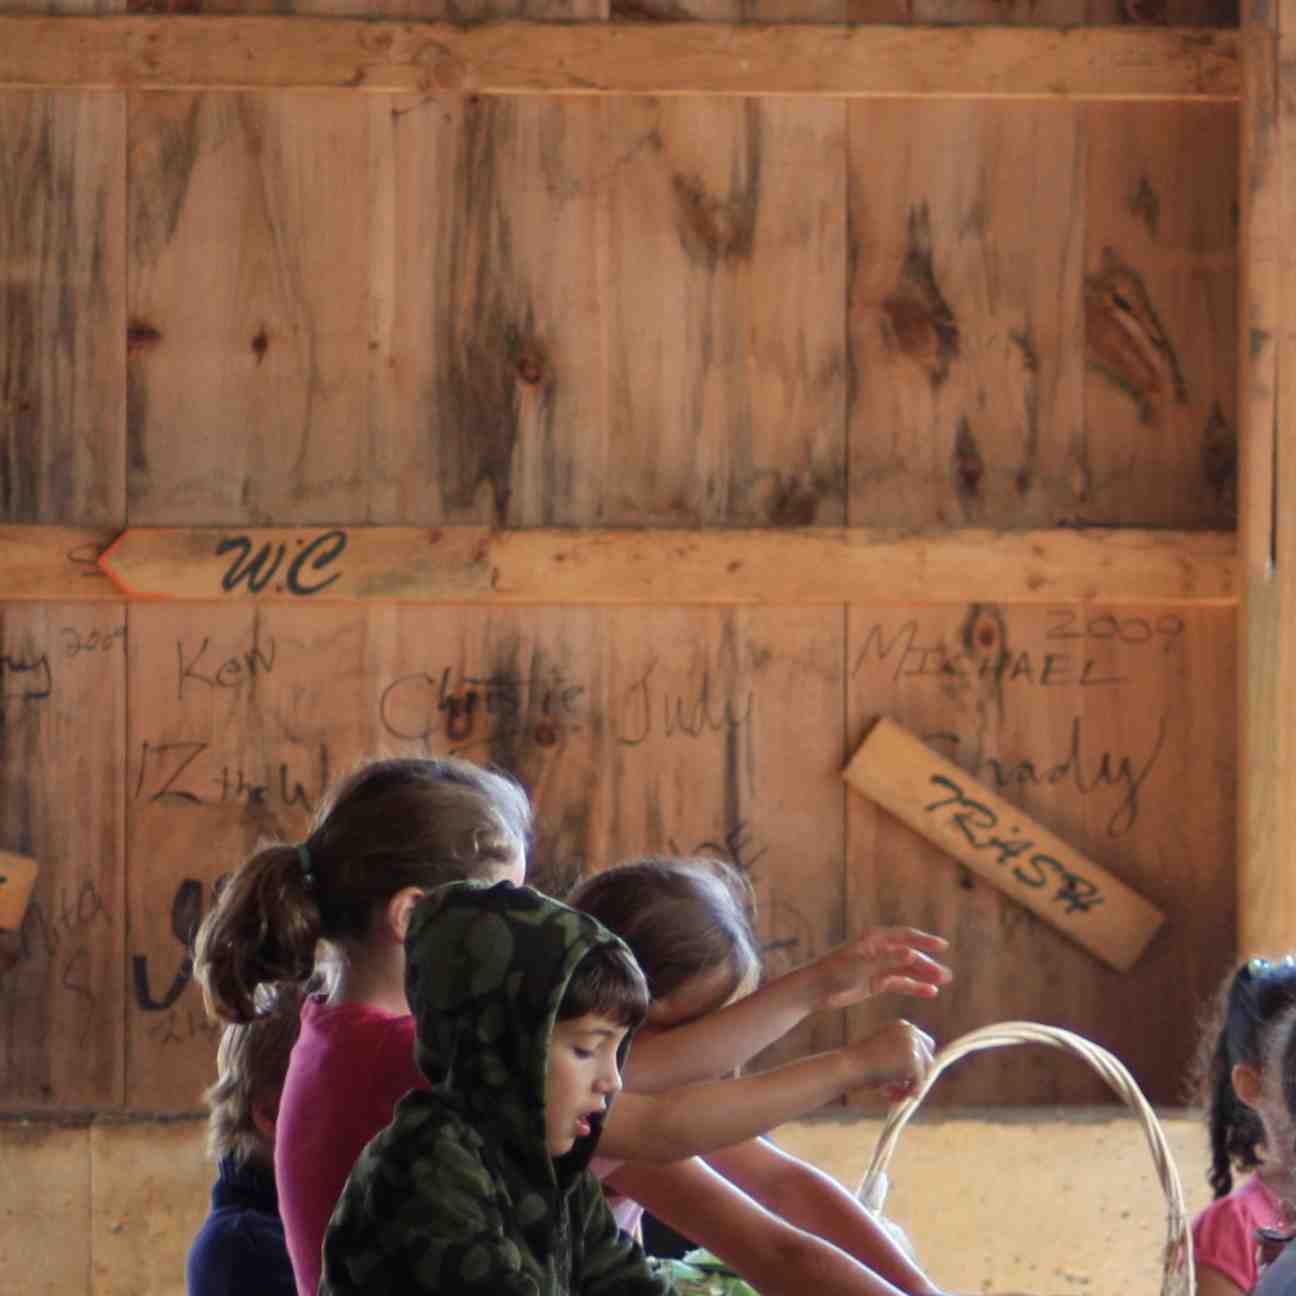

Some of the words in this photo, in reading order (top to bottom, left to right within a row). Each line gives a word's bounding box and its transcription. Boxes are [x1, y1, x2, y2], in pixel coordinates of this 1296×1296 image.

[852, 619, 1134, 692] MICHAEL
[1045, 609, 1185, 655] 2009
[924, 773, 1105, 915] TRASH
